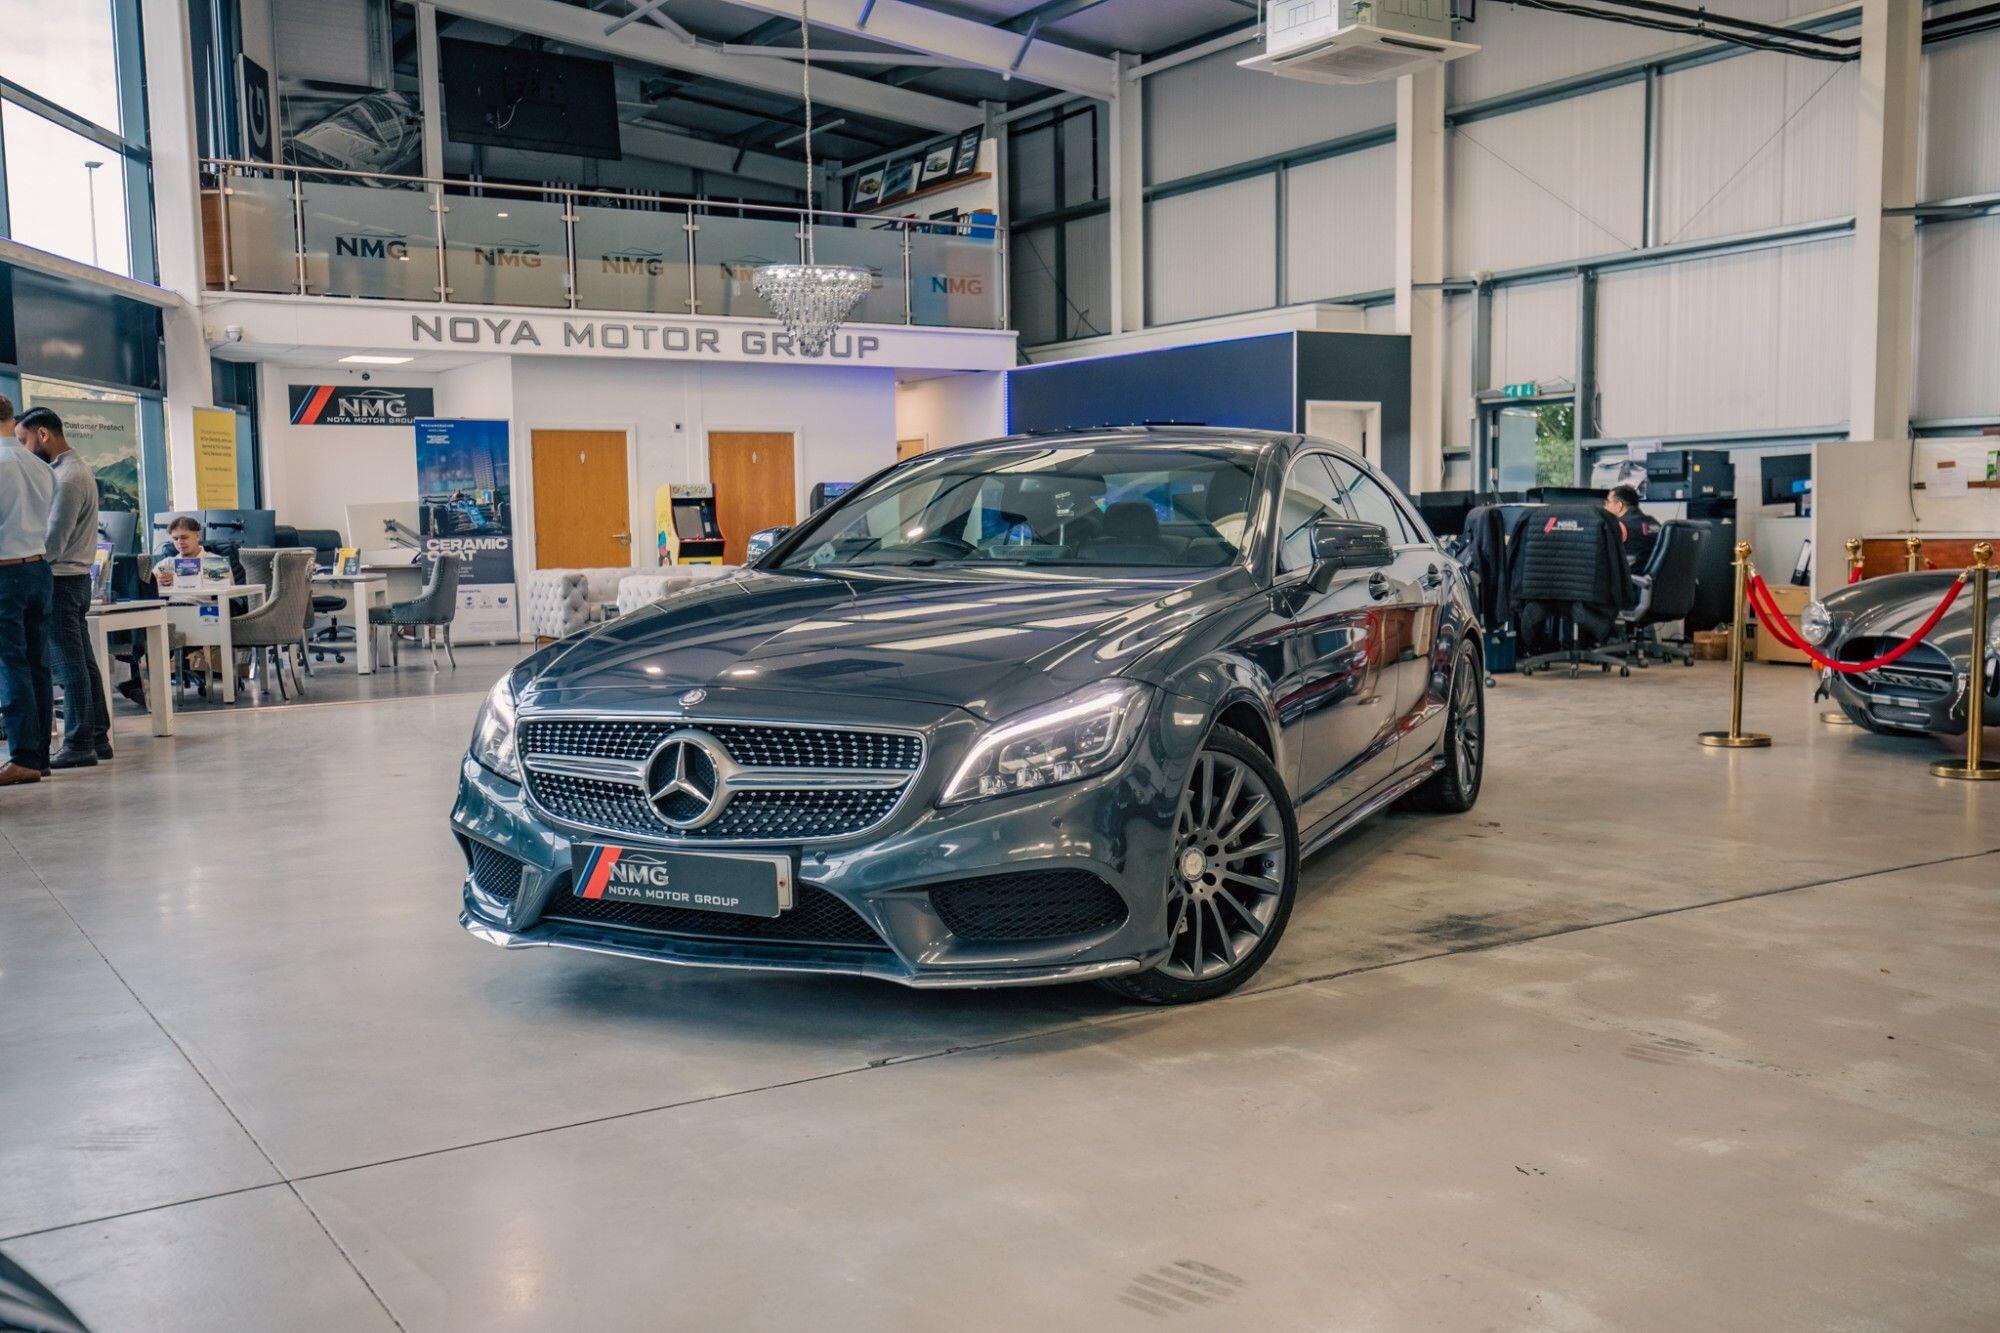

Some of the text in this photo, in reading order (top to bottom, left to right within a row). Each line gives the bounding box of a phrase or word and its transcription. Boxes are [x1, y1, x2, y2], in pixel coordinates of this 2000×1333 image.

[336, 236, 407, 259] NMG
[475, 247, 542, 268] NMG
[602, 255, 664, 276] NMG
[932, 276, 983, 295] NMG
[412, 315, 541, 346] NOYA
[564, 321, 720, 353] MOTOR
[338, 397, 407, 417] NMG
[64, 421, 125, 432] Customer Protect
[326, 416, 350, 424] NOYA
[354, 416, 385, 424] MOTOR
[427, 538, 508, 550] CERAMIC
[609, 862, 669, 886] NMG
[608, 885, 739, 907] NOYA MOTOR GROUP
